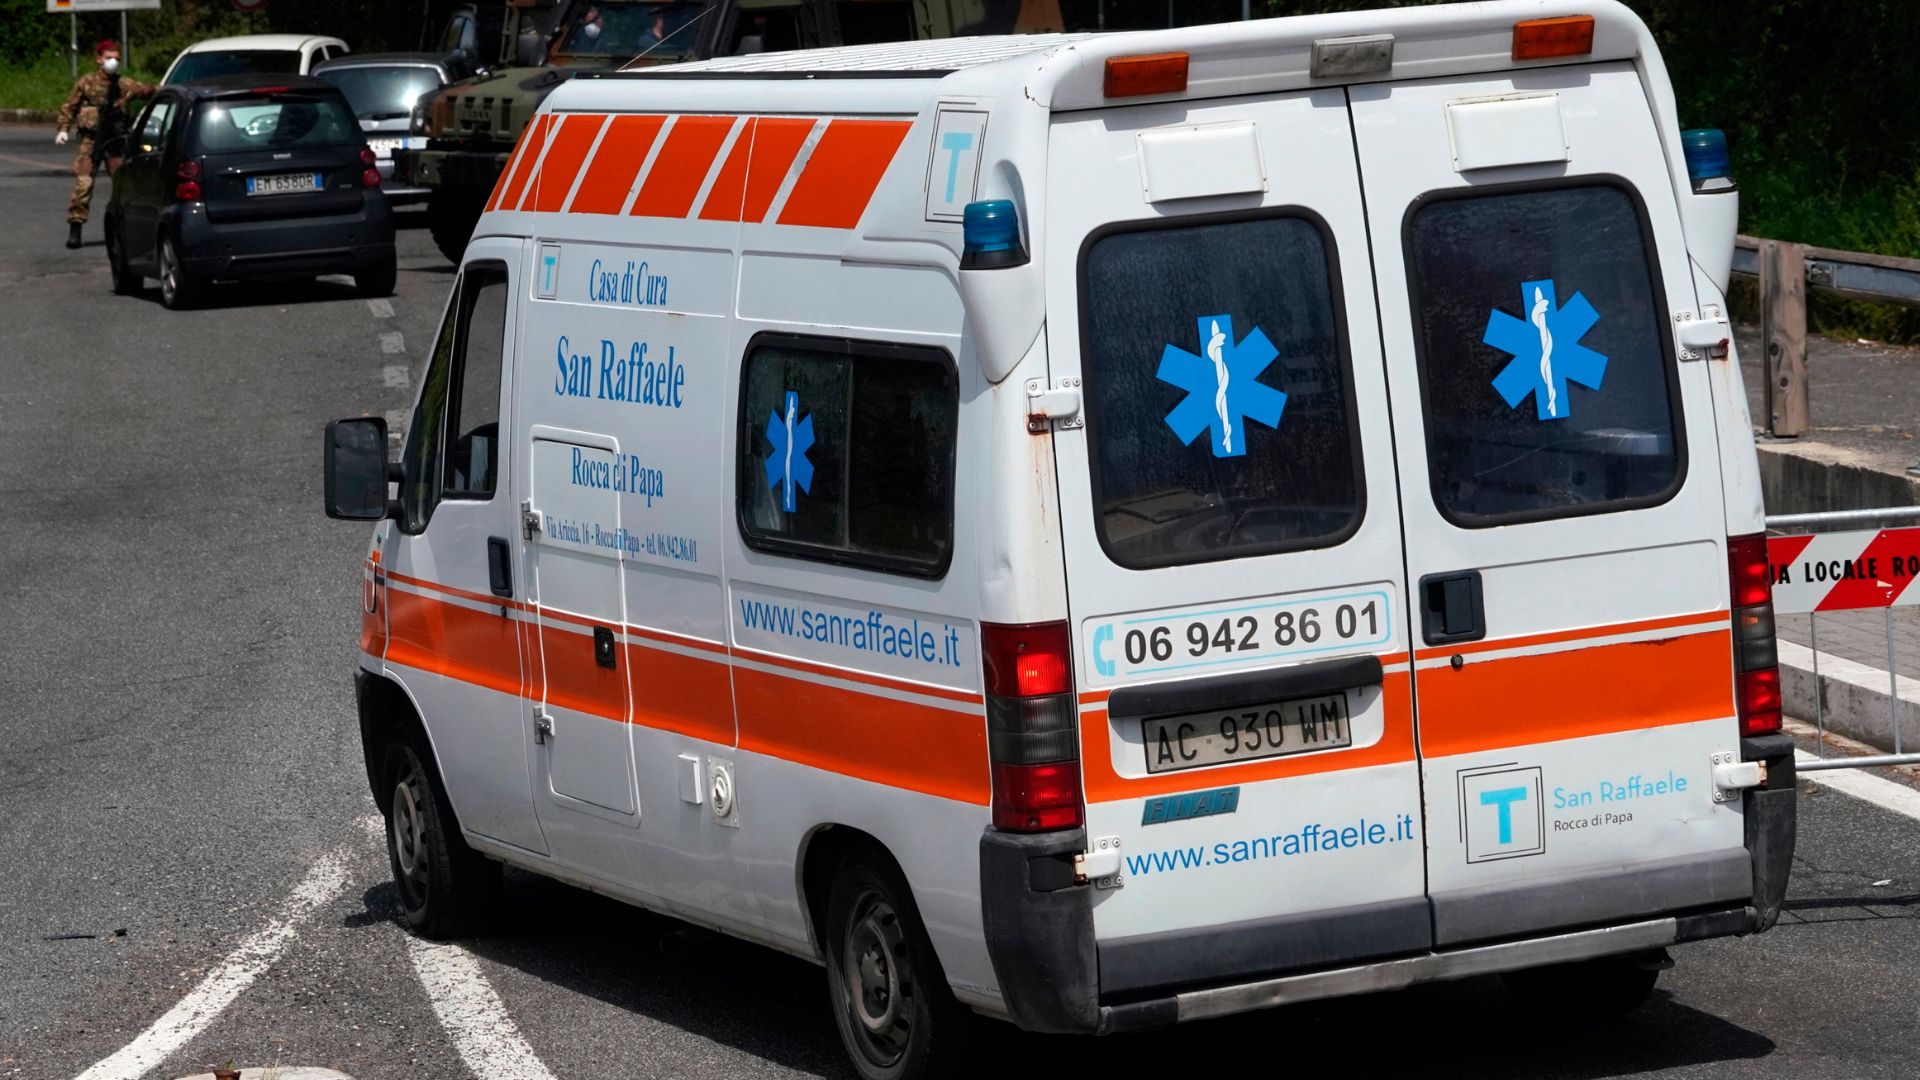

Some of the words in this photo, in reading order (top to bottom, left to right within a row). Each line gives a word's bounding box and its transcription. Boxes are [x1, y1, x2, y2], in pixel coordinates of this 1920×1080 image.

[256, 177, 272, 191] EM
[942, 132, 973, 203] T
[543, 256, 556, 291] T
[589, 259, 618, 303] Casa
[621, 260, 635, 304] di
[636, 261, 668, 306] Cura
[555, 335, 592, 398] San
[597, 339, 685, 409] Raffaele
[571, 446, 610, 491] Rocca
[613, 453, 627, 493] di
[630, 455, 664, 508] Papa
[546, 515, 557, 539] Via
[582, 522, 590, 545] 16
[595, 523, 614, 548] Rocca
[623, 528, 640, 559] Papa
[646, 532, 657, 555] tel.
[1804, 557, 1878, 583] LOCALE
[1892, 555, 1920, 577] RO
[740, 599, 960, 667] www.sanraffaele.it
[1124, 625, 1173, 664] 06
[1186, 615, 1260, 657] 942
[1274, 608, 1322, 646] 86
[1335, 600, 1378, 639] 01
[1157, 721, 1198, 766] AC
[1219, 709, 1285, 754] 930
[1298, 701, 1343, 744] WM
[1149, 791, 1236, 822] FIAT
[1480, 786, 1527, 845] T
[1553, 787, 1593, 809] San
[1600, 770, 1688, 802] Raffaele
[1126, 814, 1414, 876] www.sanraffaele.it
[1554, 817, 1588, 831] Rocca
[1591, 813, 1602, 826] di
[1605, 811, 1633, 829] Papa
